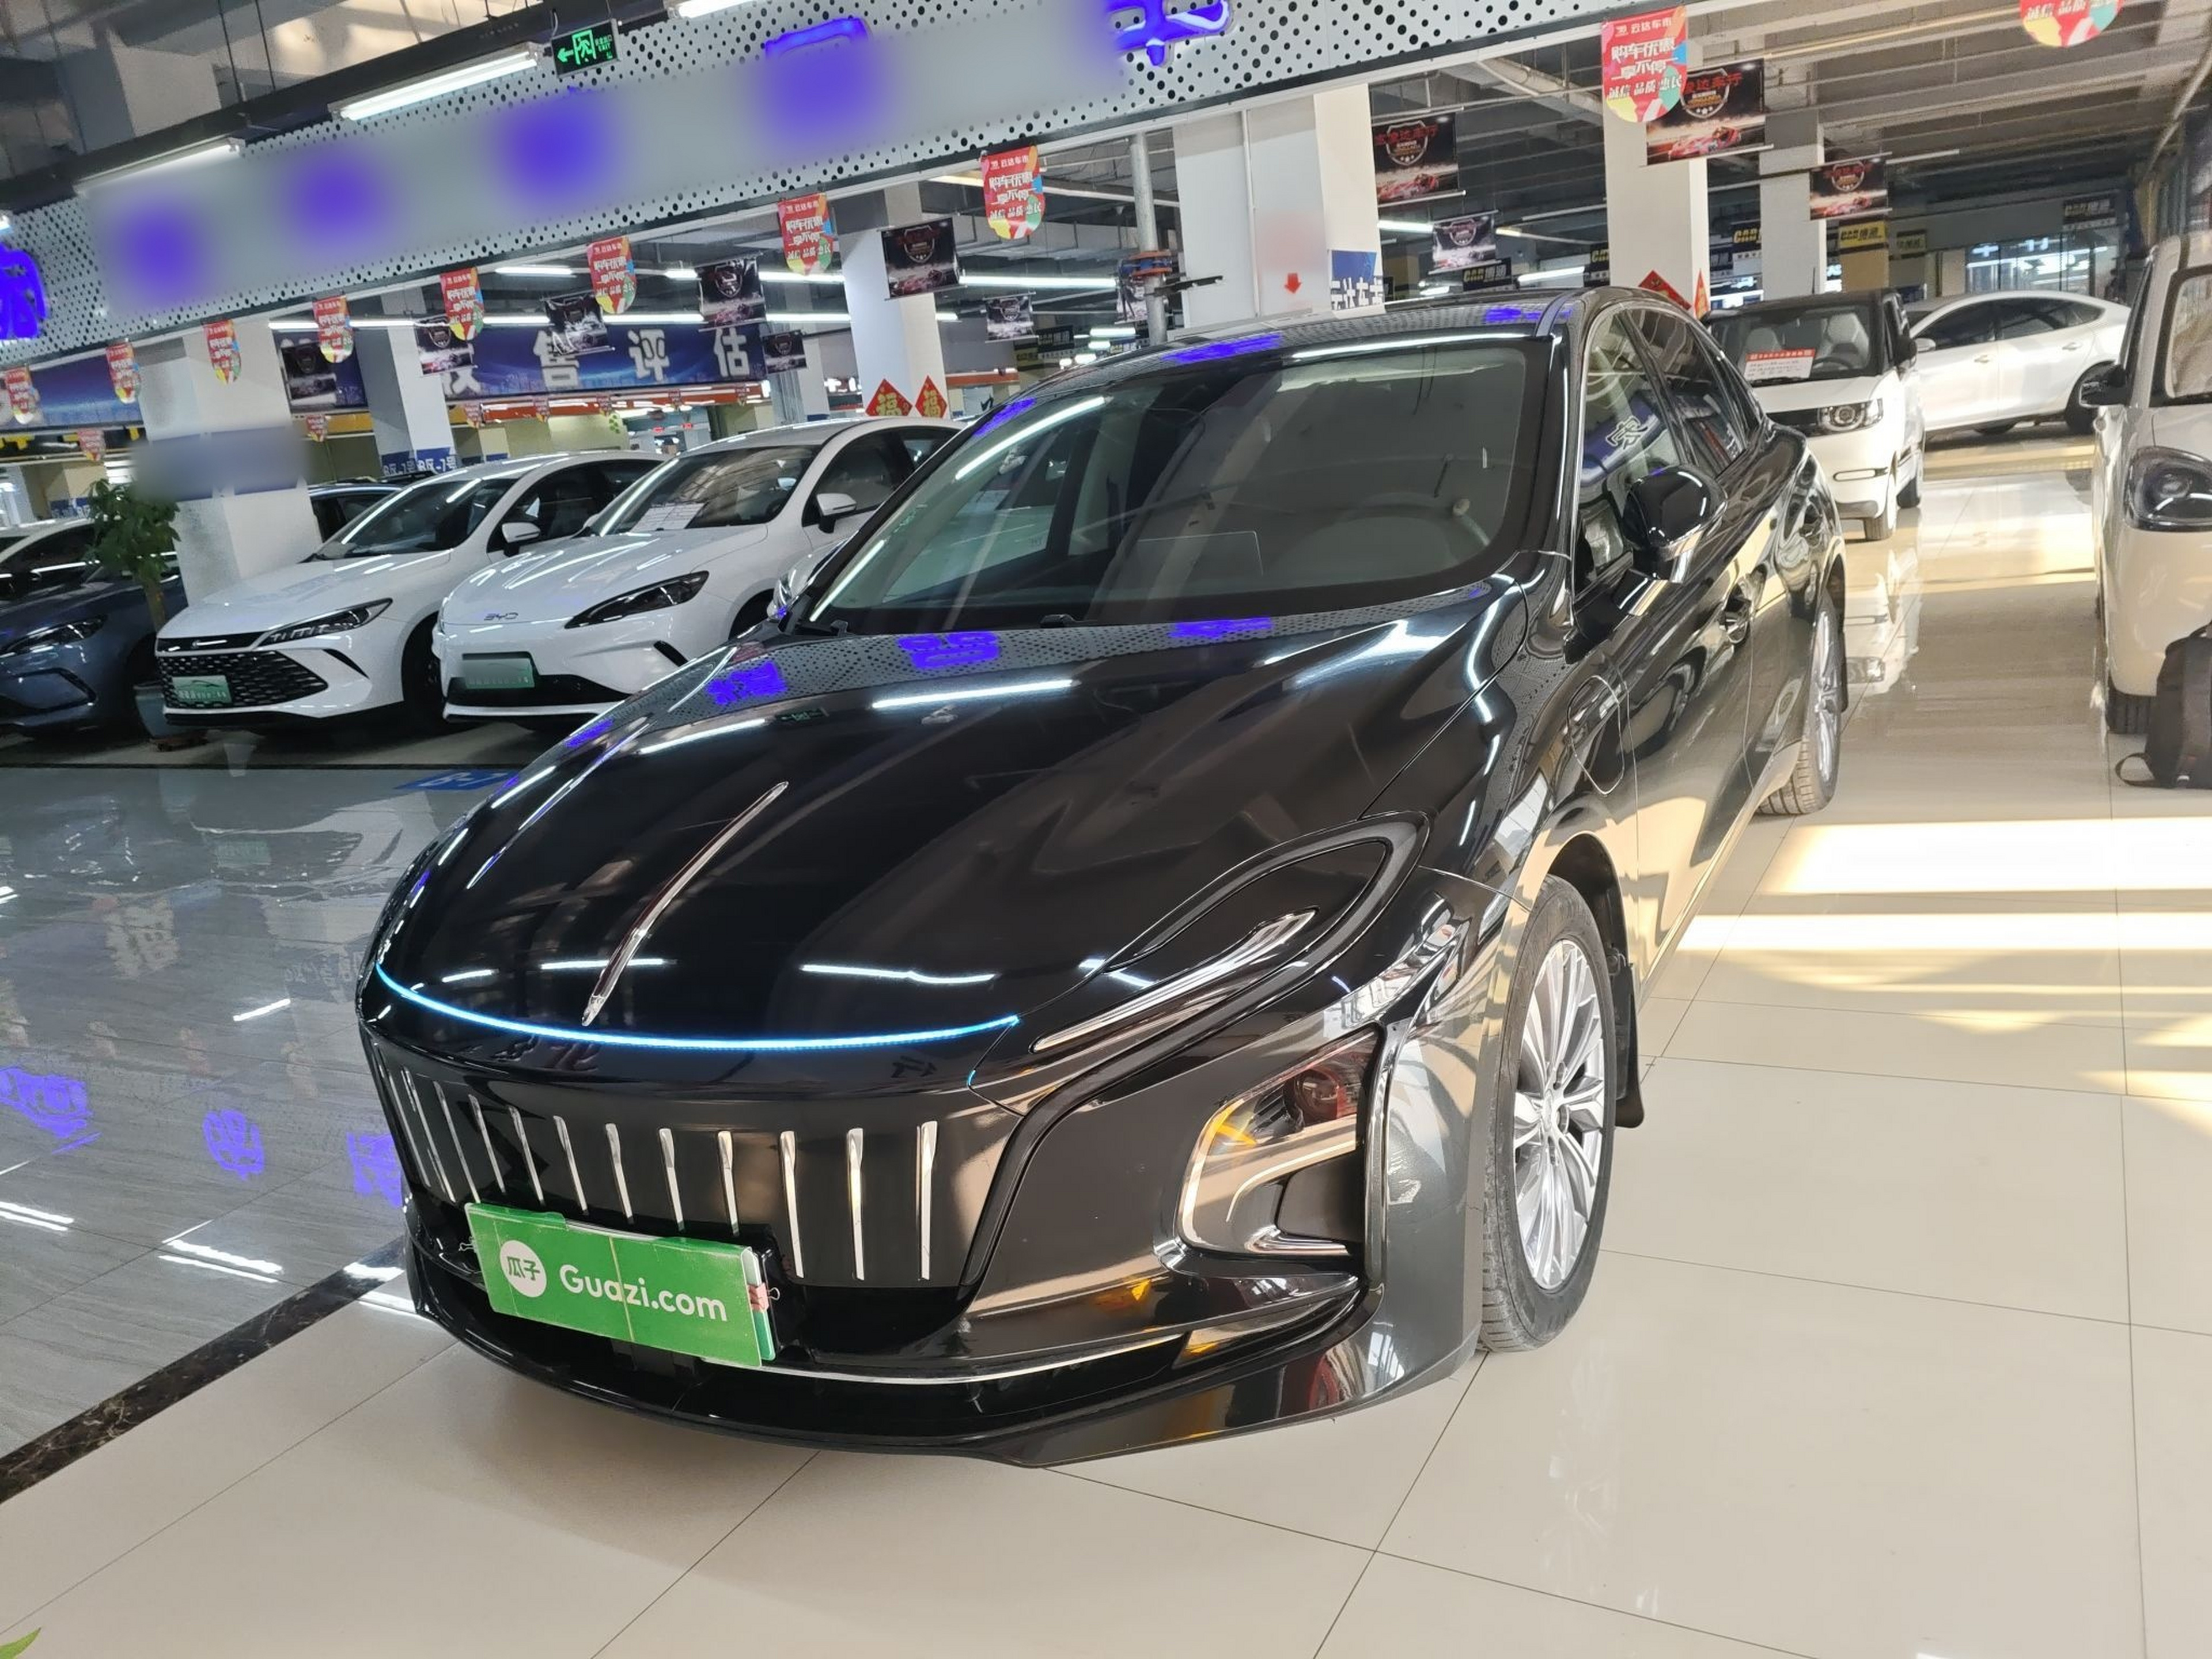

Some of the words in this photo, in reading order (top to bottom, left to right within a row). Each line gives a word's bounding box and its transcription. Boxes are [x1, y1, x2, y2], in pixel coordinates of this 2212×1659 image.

[923, 389, 941, 417] 福
[484, 612, 518, 622] BYD
[507, 1256, 540, 1282] 瓜子
[559, 1264, 727, 1322] Guazi.com
